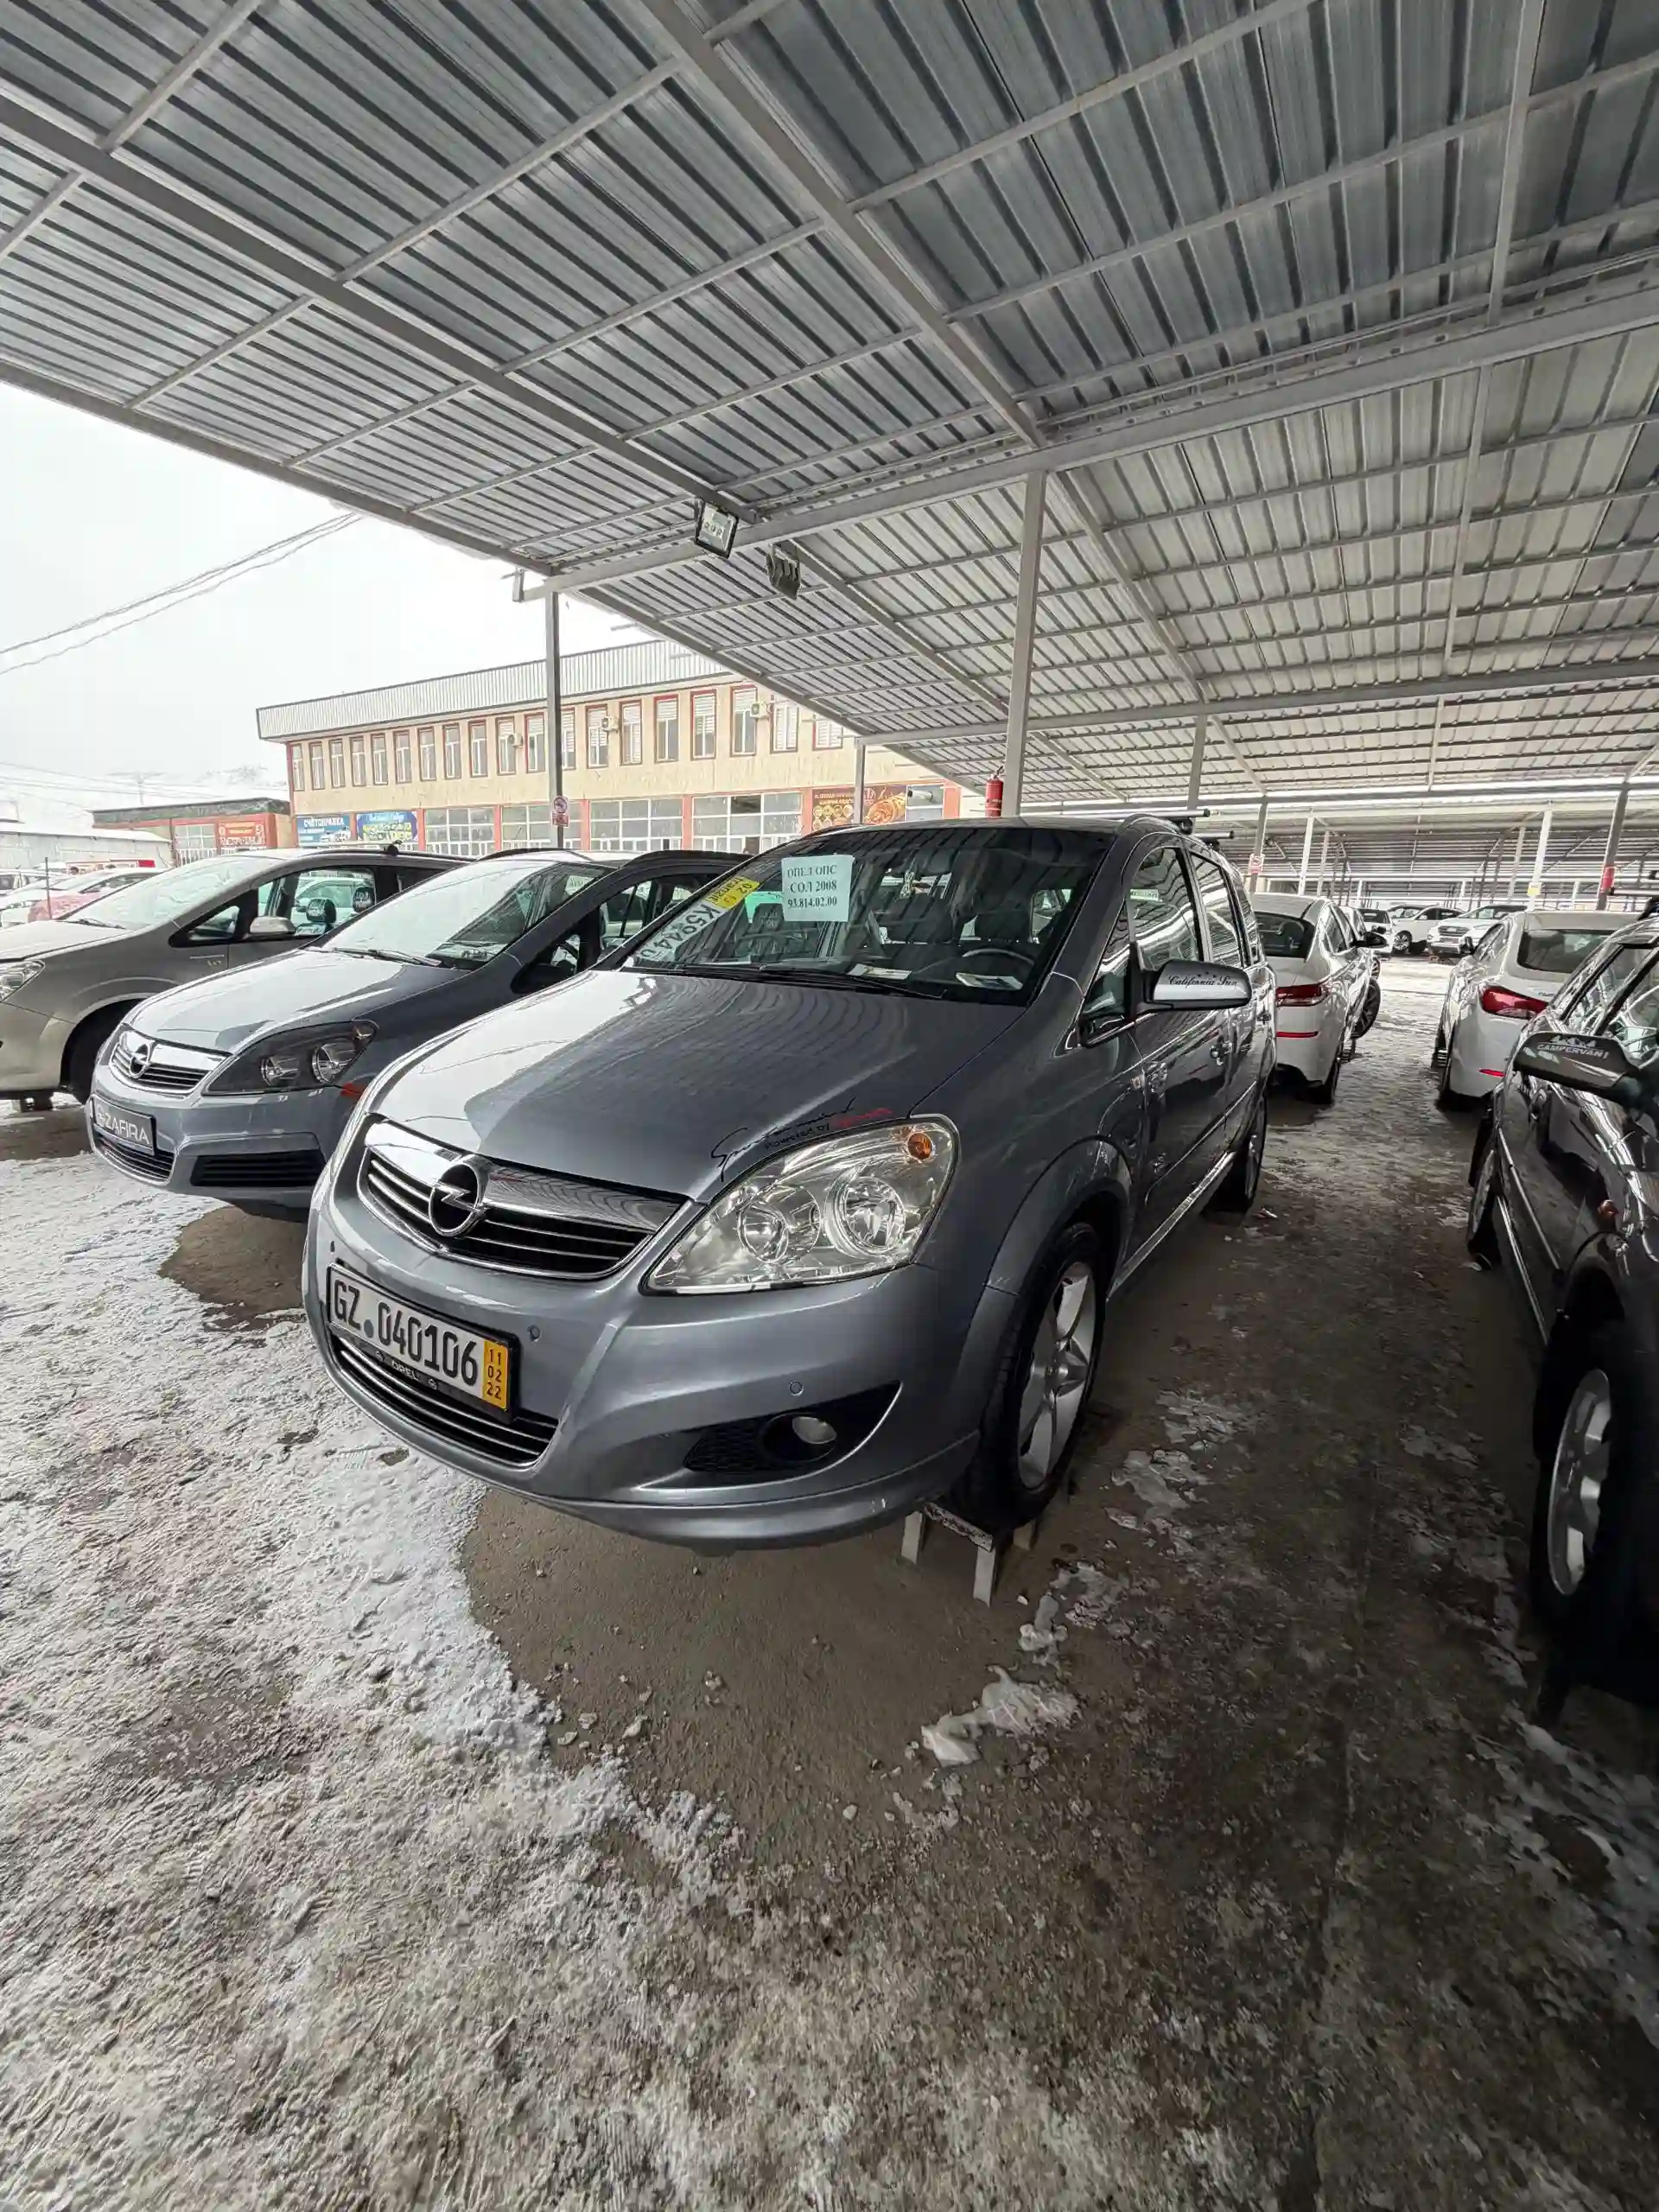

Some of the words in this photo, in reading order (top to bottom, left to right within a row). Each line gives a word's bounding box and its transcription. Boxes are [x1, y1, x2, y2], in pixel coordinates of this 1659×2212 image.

[815, 880, 837, 893] 2008
[1168, 976, 1215, 988] California
[1217, 974, 1238, 987] Sun
[105, 1112, 150, 1145] ZAFIRA
[334, 1279, 361, 1331] GZ
[378, 1301, 478, 1386] 040106
[489, 1348, 502, 1366] 11
[391, 1360, 419, 1382] OPEL
[487, 1364, 502, 1383] 02
[486, 1381, 502, 1401] 22
